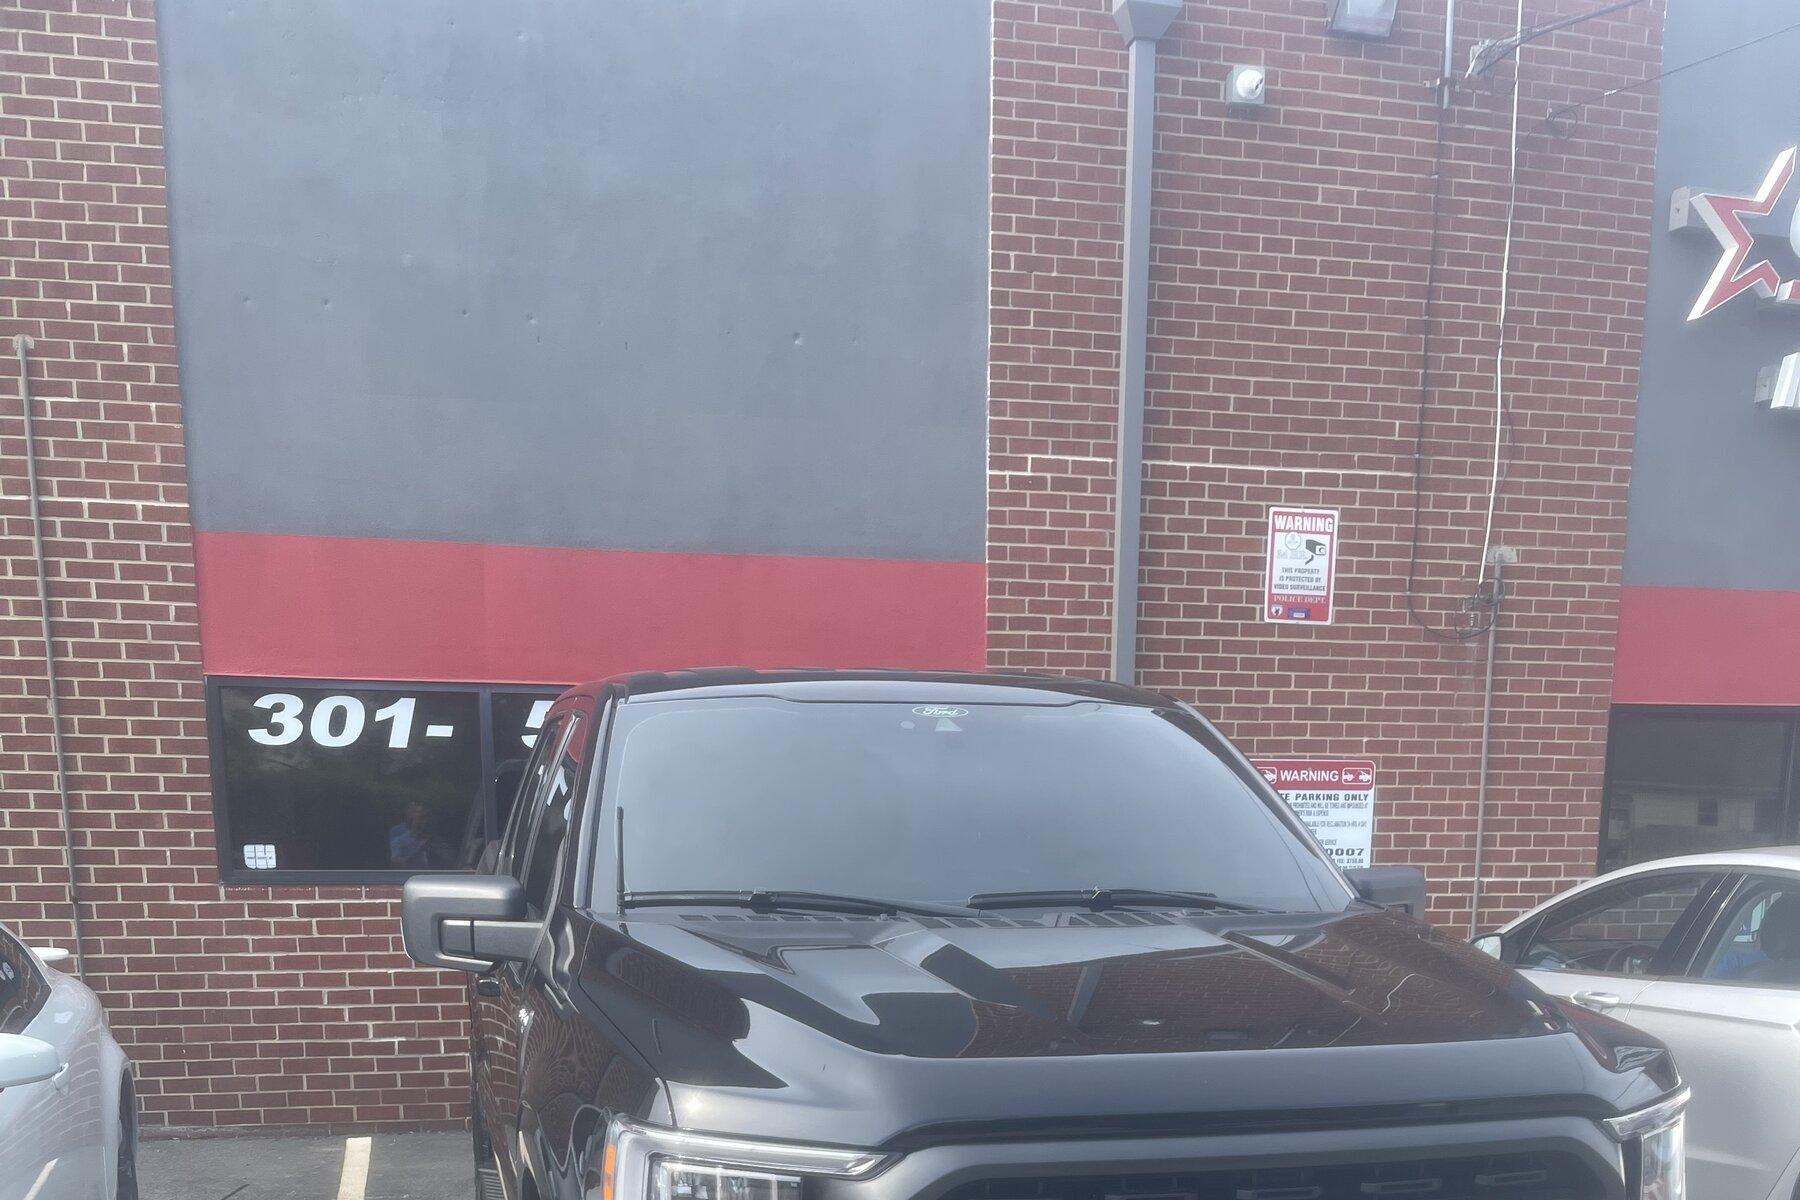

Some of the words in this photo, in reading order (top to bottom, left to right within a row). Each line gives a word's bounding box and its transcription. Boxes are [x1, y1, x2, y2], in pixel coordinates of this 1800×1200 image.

[1274, 514, 1334, 533] WARNING
[1285, 575, 1314, 583] PROTECTED
[1289, 584, 1326, 592] SURVEILLANCE
[922, 706, 959, 716] Ford
[1280, 769, 1339, 782] WARNING
[1295, 793, 1340, 802] PARKING
[1344, 793, 1369, 802] ONLY
